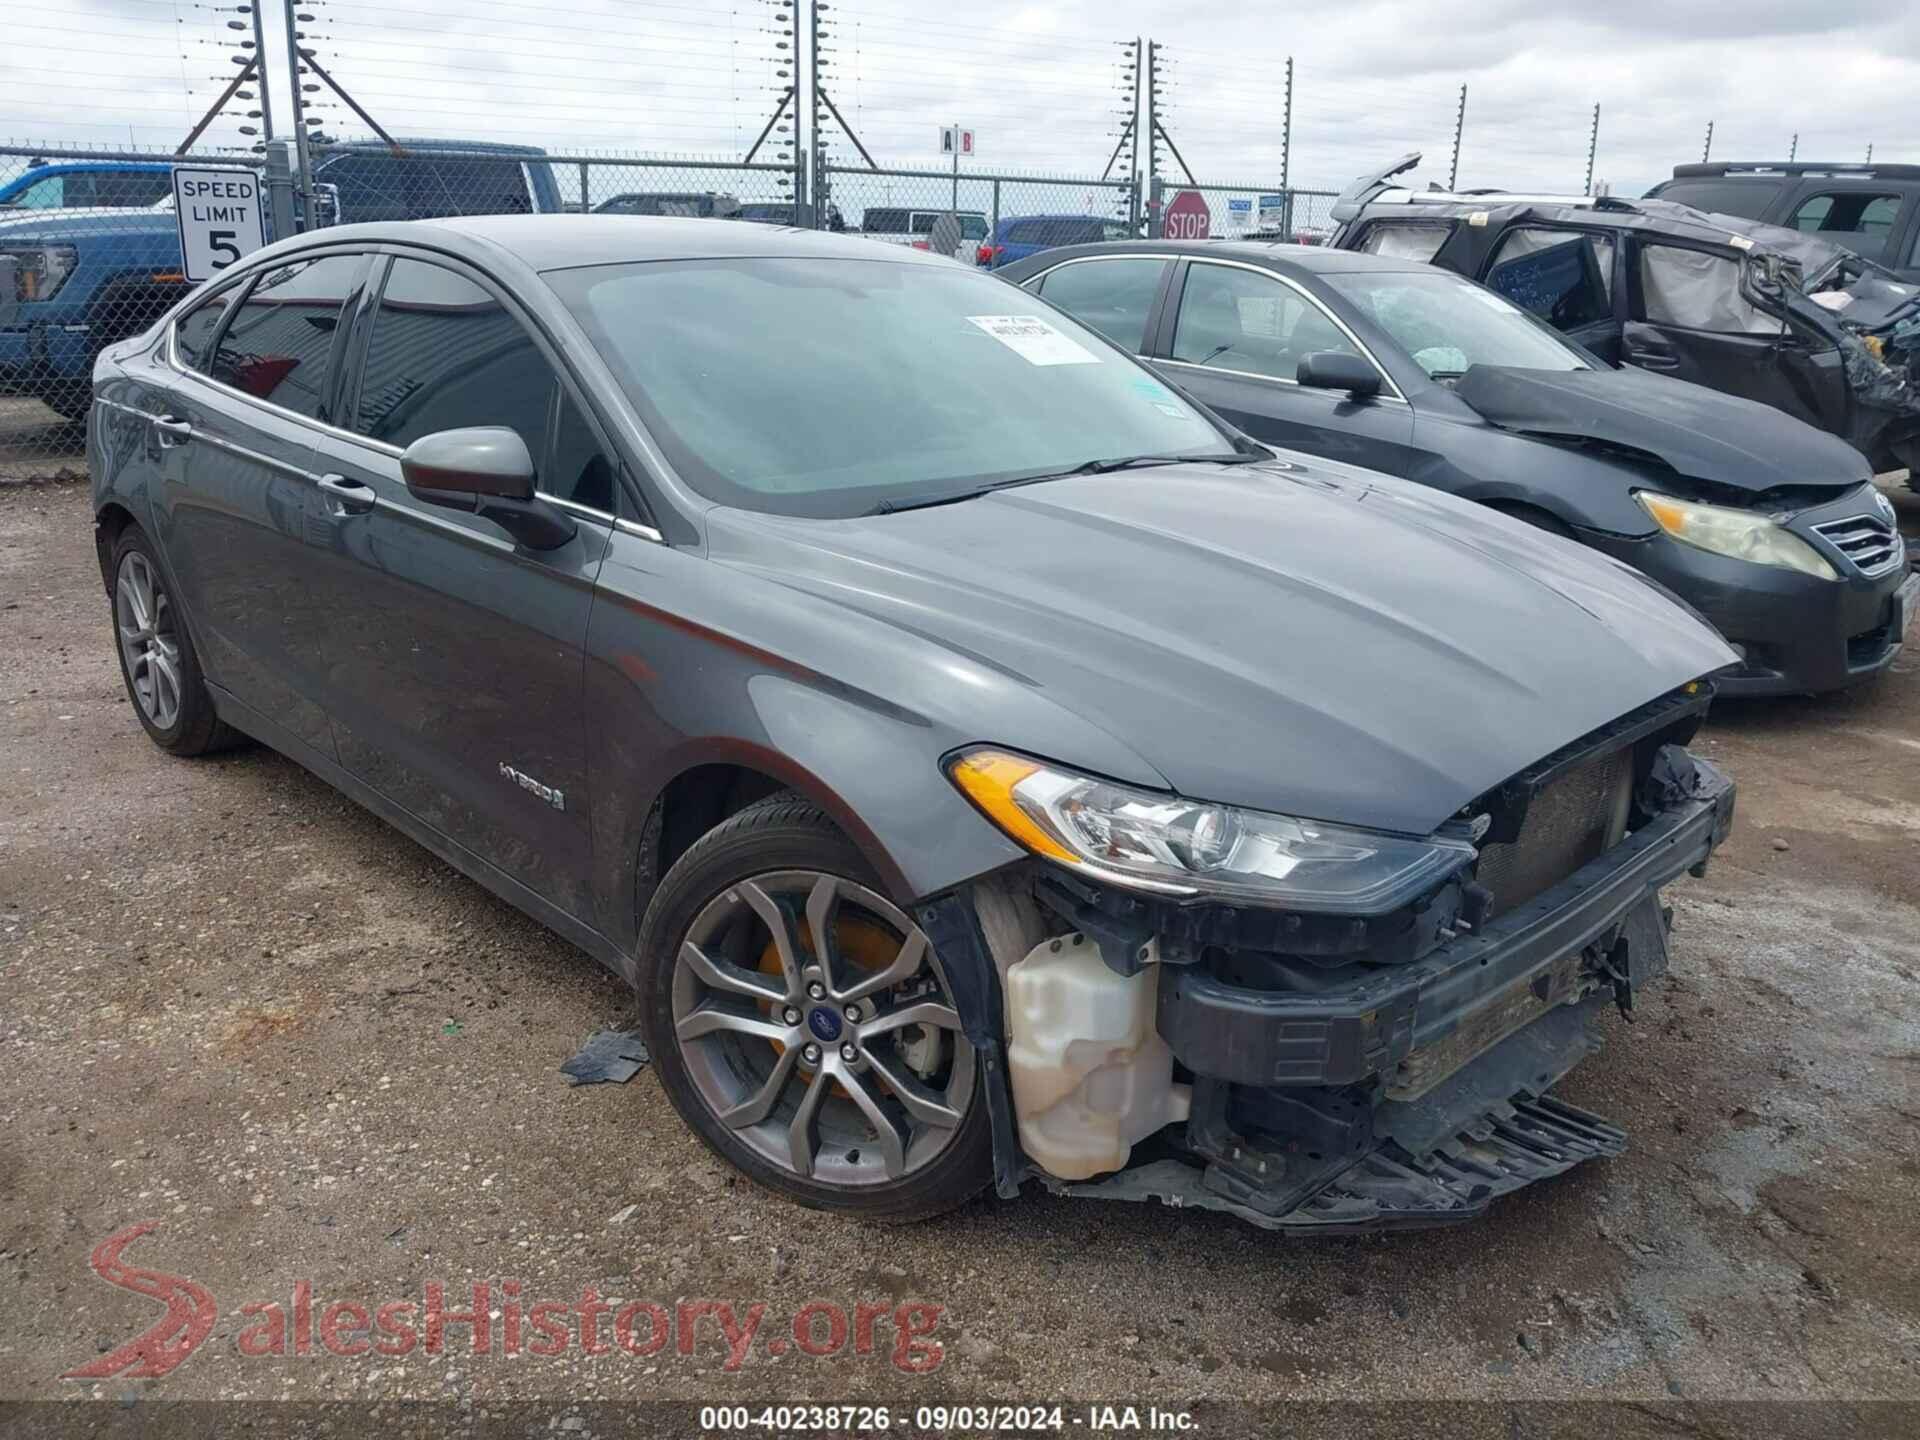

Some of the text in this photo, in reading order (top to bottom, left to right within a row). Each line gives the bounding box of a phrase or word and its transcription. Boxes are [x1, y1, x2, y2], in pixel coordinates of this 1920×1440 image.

[943, 130, 953, 151] A
[963, 132, 971, 152] B
[183, 180, 252, 199] SPEED
[192, 205, 247, 222] LIMIT
[1167, 213, 1208, 239] STOP
[208, 230, 242, 270] 5
